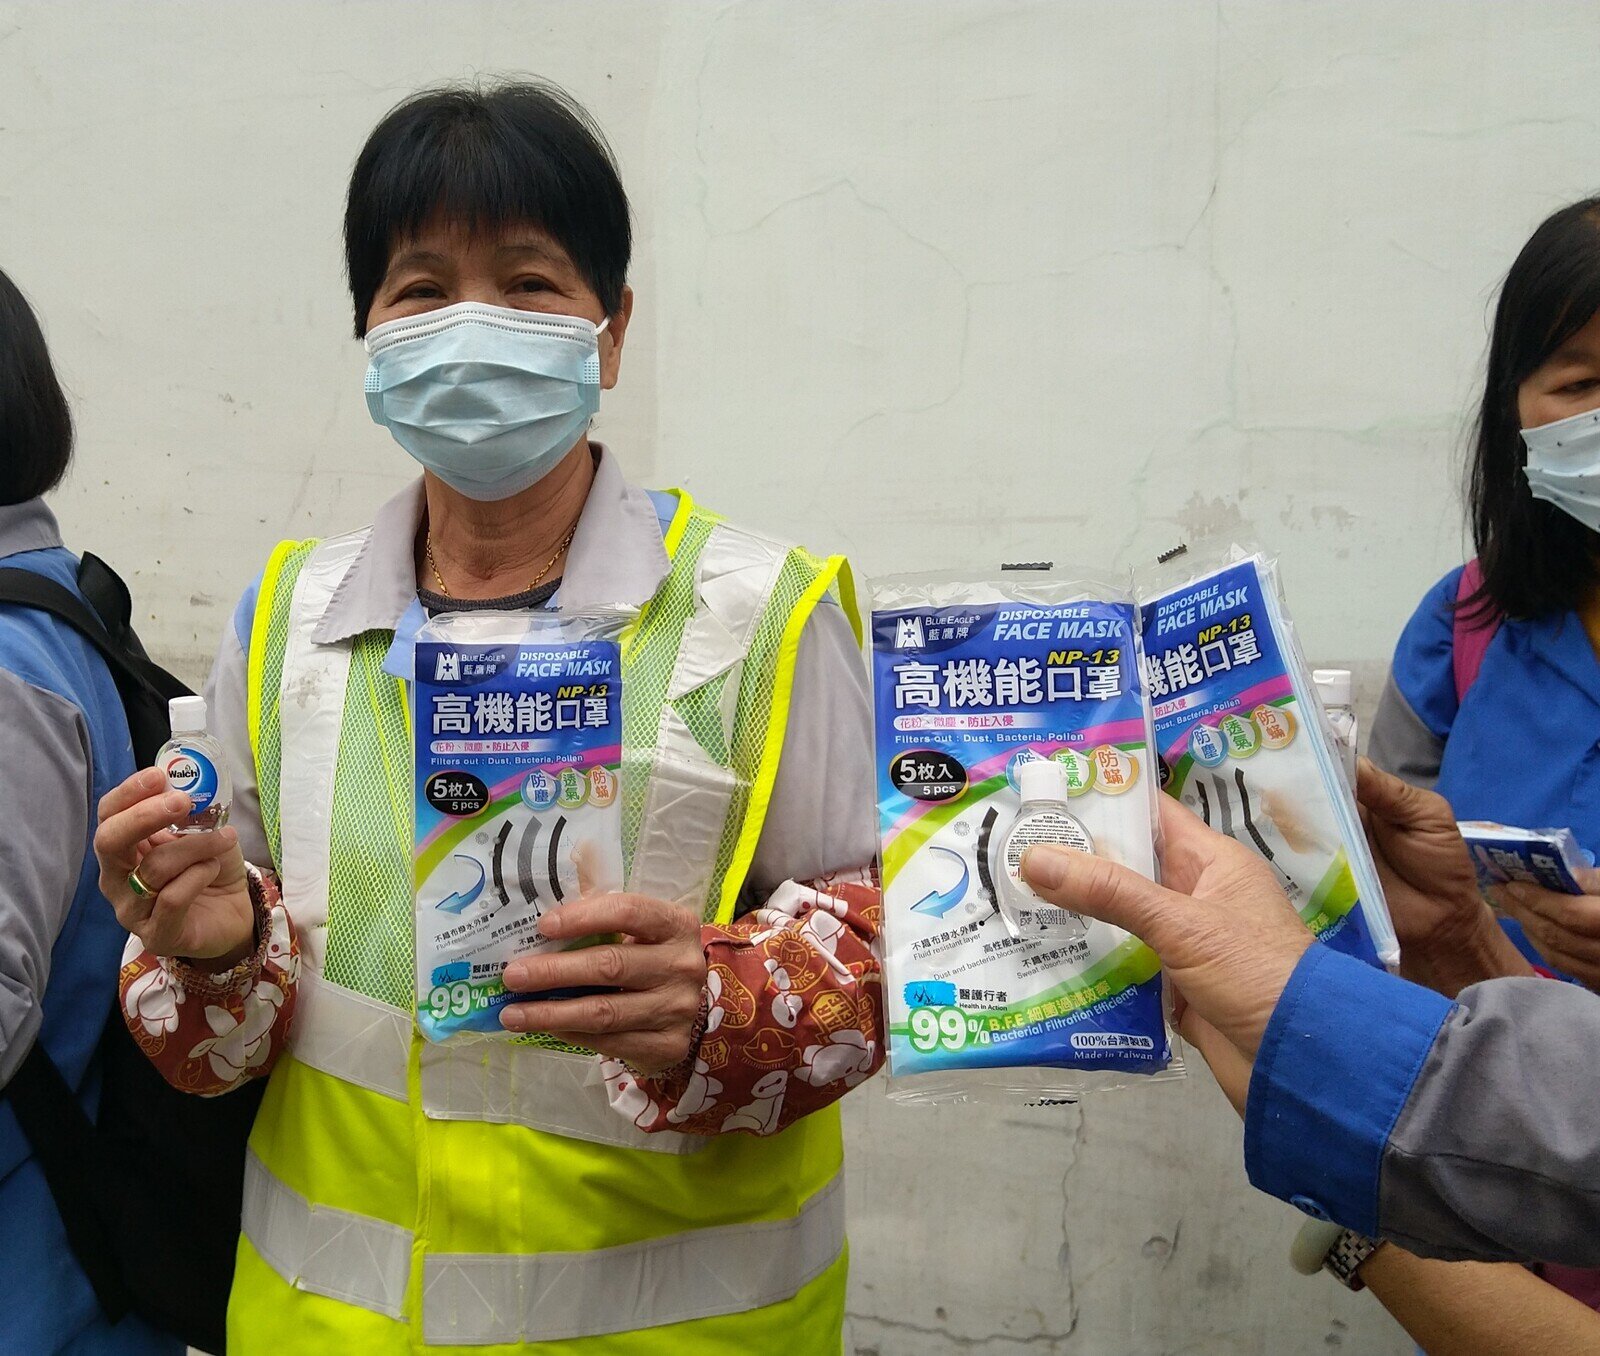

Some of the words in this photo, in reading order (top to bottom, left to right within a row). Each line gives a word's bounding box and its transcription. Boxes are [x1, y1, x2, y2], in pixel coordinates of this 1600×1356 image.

[1157, 584, 1219, 617] DISPOSABLE
[998, 608, 1090, 622] DISPOSABLE
[1156, 607, 1196, 636] FACE
[1200, 586, 1248, 620] MASK
[925, 617, 946, 626] BLUE
[992, 623, 1050, 641] FACE
[1057, 619, 1125, 638] MASK
[1198, 614, 1251, 645] NP-13
[928, 626, 969, 641] 藍鷹牌
[461, 654, 478, 662] BLUE
[520, 650, 590, 661] DISPOSABLE
[1046, 650, 1120, 665] NP-13
[462, 664, 497, 676] 藍鷹牌
[516, 662, 560, 678] FACE
[565, 660, 612, 676] MASK
[556, 685, 608, 698] NP-13
[893, 658, 1122, 708] 高機能口罩
[432, 692, 610, 735] 高機能口罩
[1176, 707, 1212, 724] Bacteria,
[1213, 698, 1240, 713] Pollen
[896, 734, 930, 744] Filters
[934, 735, 952, 744] out
[963, 734, 992, 744] Dust,
[996, 732, 1046, 744] Bacteria,
[1048, 732, 1084, 742] Pollen
[430, 756, 461, 766] Filters
[464, 758, 480, 766] out
[487, 756, 512, 766] Dust,
[514, 756, 554, 765] Bacteria,
[556, 754, 584, 762] Pollen
[168, 770, 198, 778] Walch
[900, 760, 954, 782] 5枚入
[433, 778, 478, 798] 5枚入
[923, 786, 930, 795] 5
[934, 784, 956, 796] pcs
[452, 802, 459, 811] 5
[460, 800, 480, 811] pcs
[436, 940, 450, 950] Fluid
[476, 924, 490, 934] layer
[466, 950, 477, 958] and
[477, 940, 500, 953] bacteria
[500, 930, 524, 942] blocking
[524, 924, 538, 932] layer
[913, 948, 931, 960] Fluid
[932, 939, 964, 957] resistant
[964, 933, 982, 948] layer
[934, 970, 952, 981] Dust
[953, 965, 966, 976] and
[966, 956, 996, 970] bacteria
[996, 945, 1025, 963] blocking
[1026, 940, 1044, 953] layer
[1016, 966, 1040, 980] Sweat
[1074, 949, 1092, 962] layer
[430, 983, 488, 1018] 99%
[959, 988, 1008, 1002] 醫護行者
[988, 1004, 1008, 1012] Action
[992, 1025, 1043, 1044] Bacterial
[1046, 1010, 1094, 1032] Filtration
[1094, 985, 1138, 1016] Efficiency
[912, 1009, 990, 1050] 99%
[1074, 1050, 1102, 1060] Made
[1118, 1050, 1153, 1060] Taiwan
